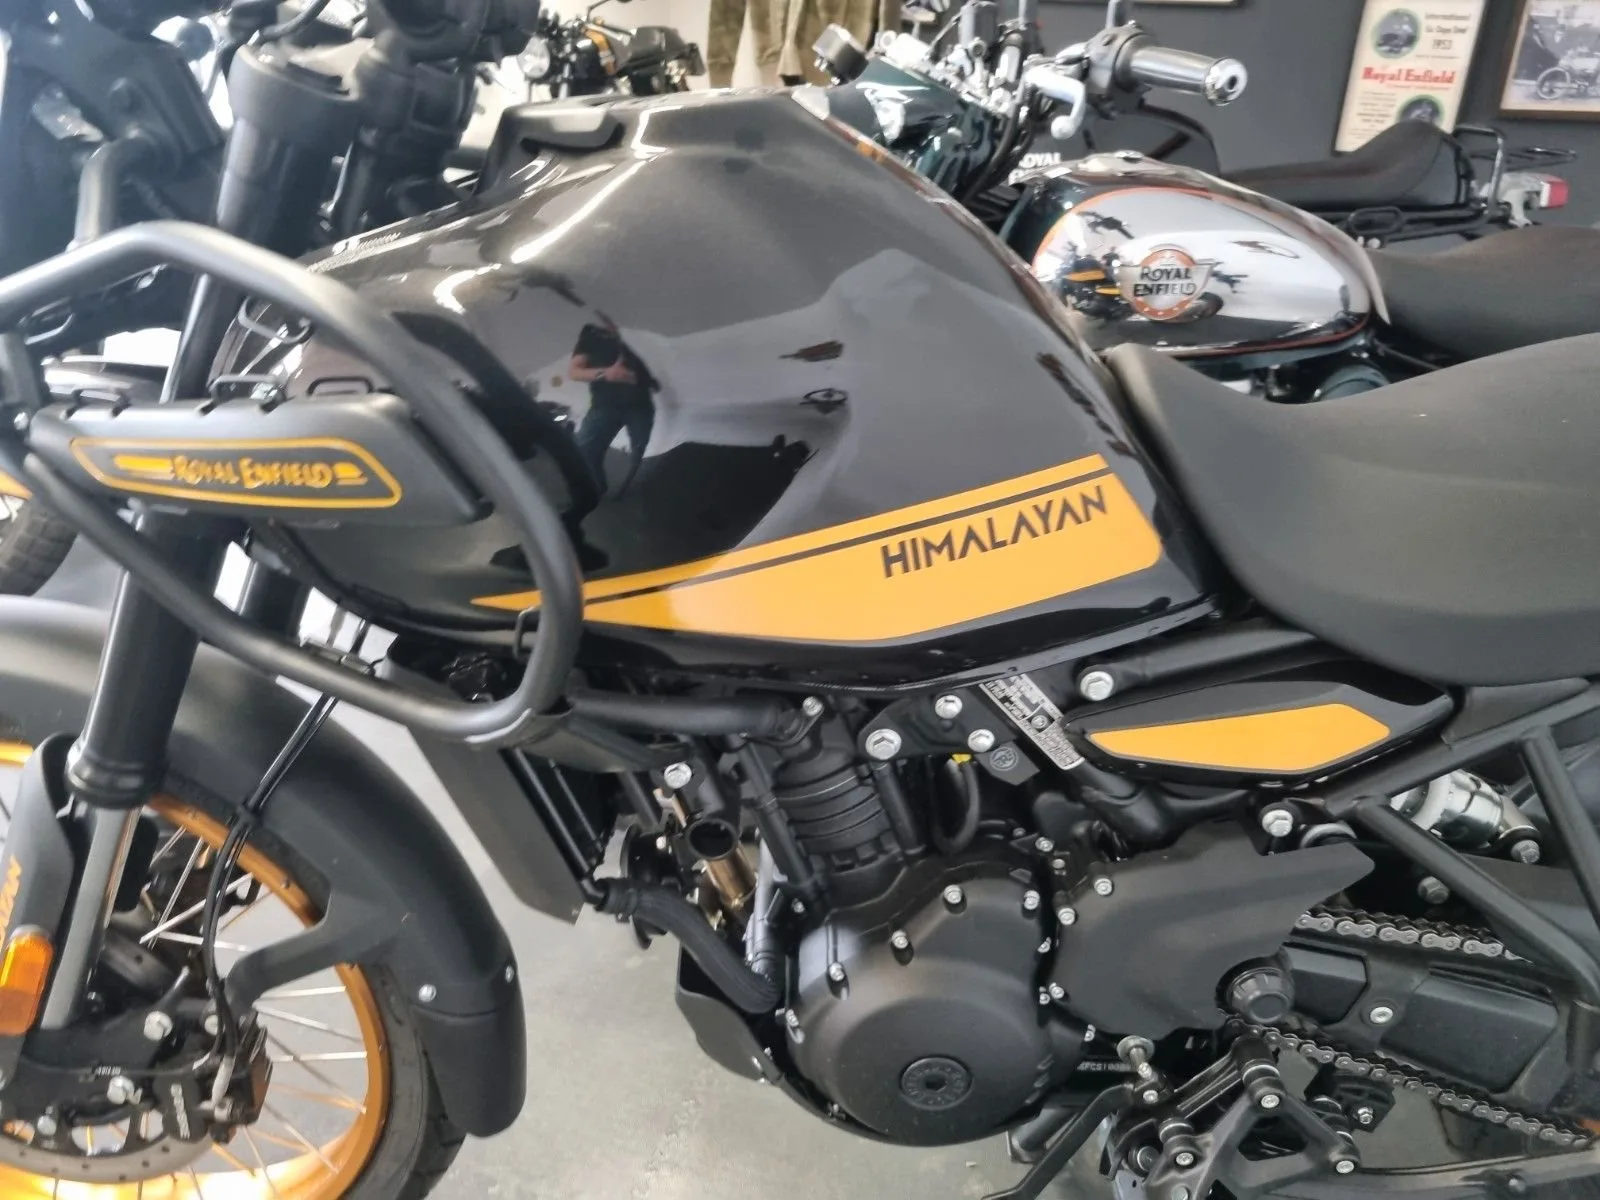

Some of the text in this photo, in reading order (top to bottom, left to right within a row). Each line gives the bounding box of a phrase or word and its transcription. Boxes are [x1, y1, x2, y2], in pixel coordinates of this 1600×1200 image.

[1363, 67, 1456, 84] Royal Enfield
[1018, 152, 1061, 168] OYAL
[1141, 267, 1192, 281] ROYAL
[1134, 283, 1197, 297] ENFIELD
[239, 457, 333, 489] ENFIELD
[880, 485, 1107, 579] HIMALAYAN
